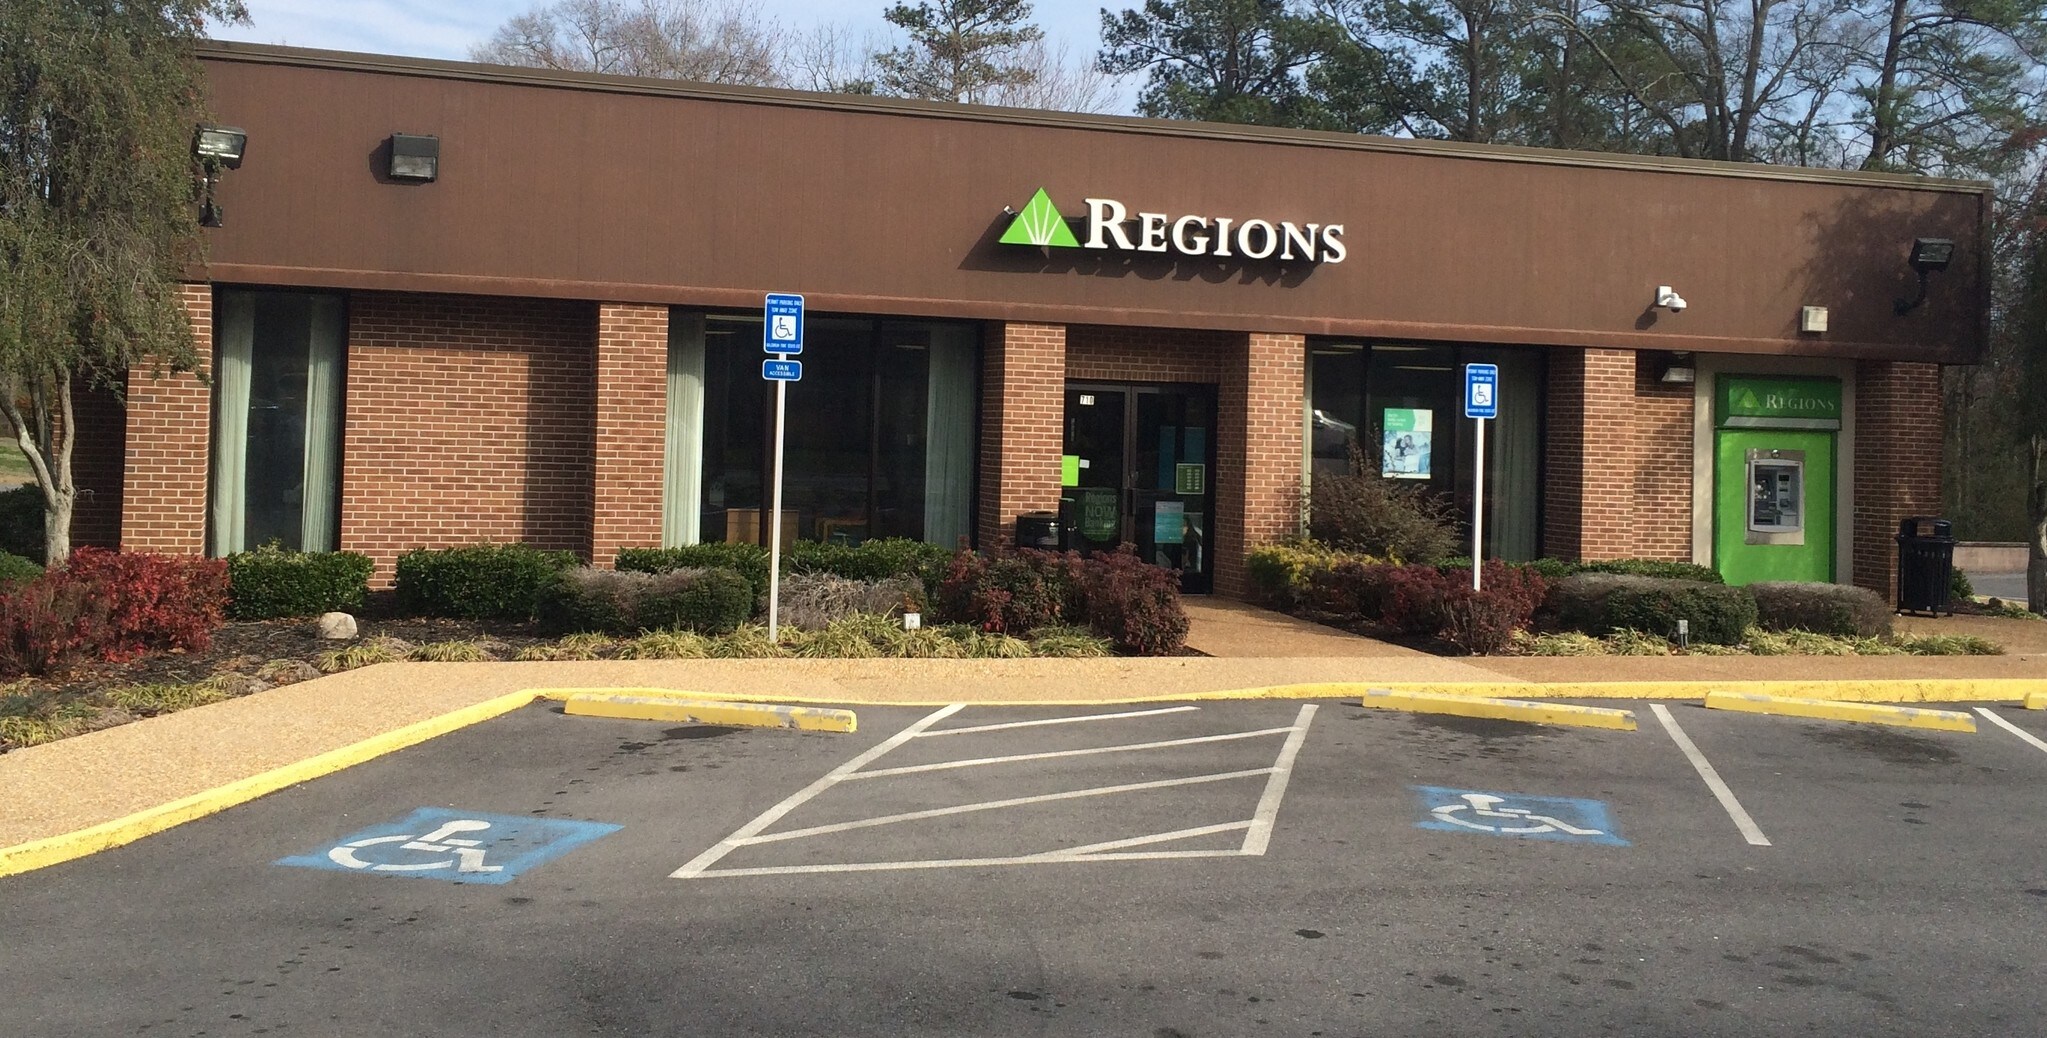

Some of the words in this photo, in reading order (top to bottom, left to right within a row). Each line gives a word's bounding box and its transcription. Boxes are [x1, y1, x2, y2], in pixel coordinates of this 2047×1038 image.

[1084, 197, 1347, 264] REGIONS
[1081, 395, 1093, 404] 710
[1766, 394, 1835, 411] REGIONS
[1085, 506, 1117, 518] NOW
